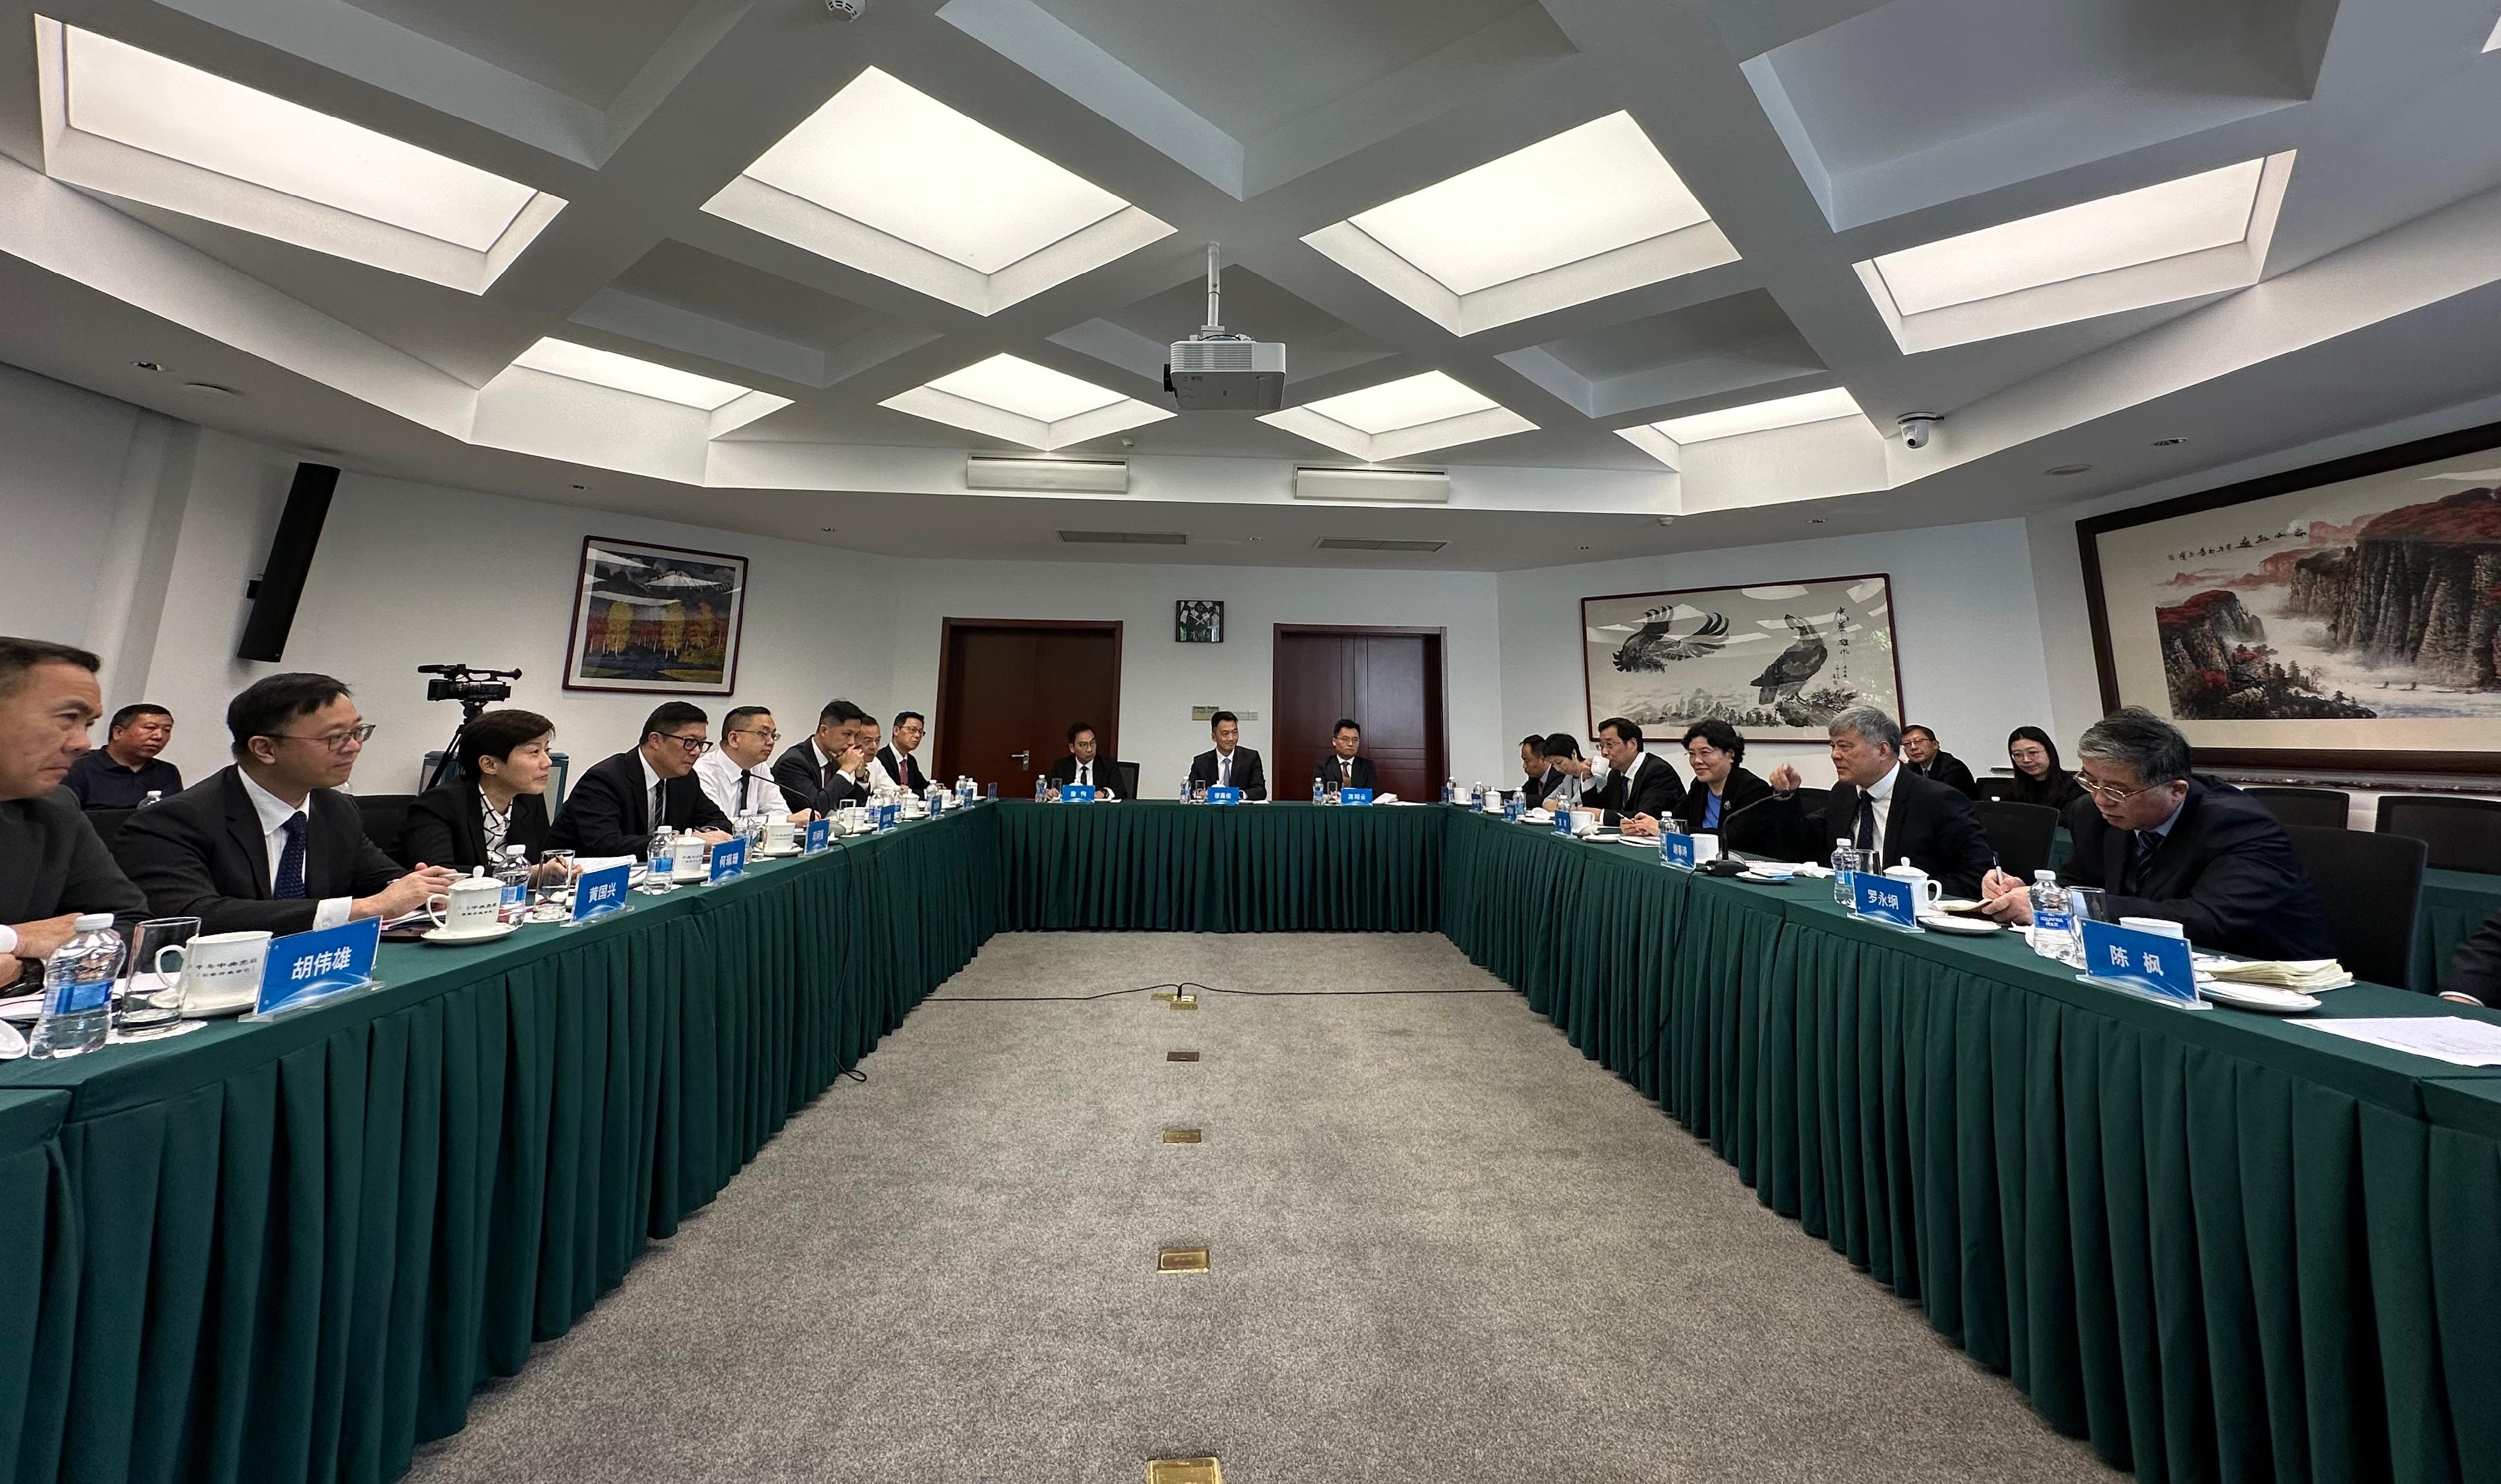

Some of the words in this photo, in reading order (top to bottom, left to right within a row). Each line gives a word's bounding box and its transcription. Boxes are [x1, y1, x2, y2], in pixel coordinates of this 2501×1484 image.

[588, 881, 616, 903] 黄国兴
[1867, 889, 1899, 910] 罗永纲
[291, 946, 352, 980] 胡伟雄
